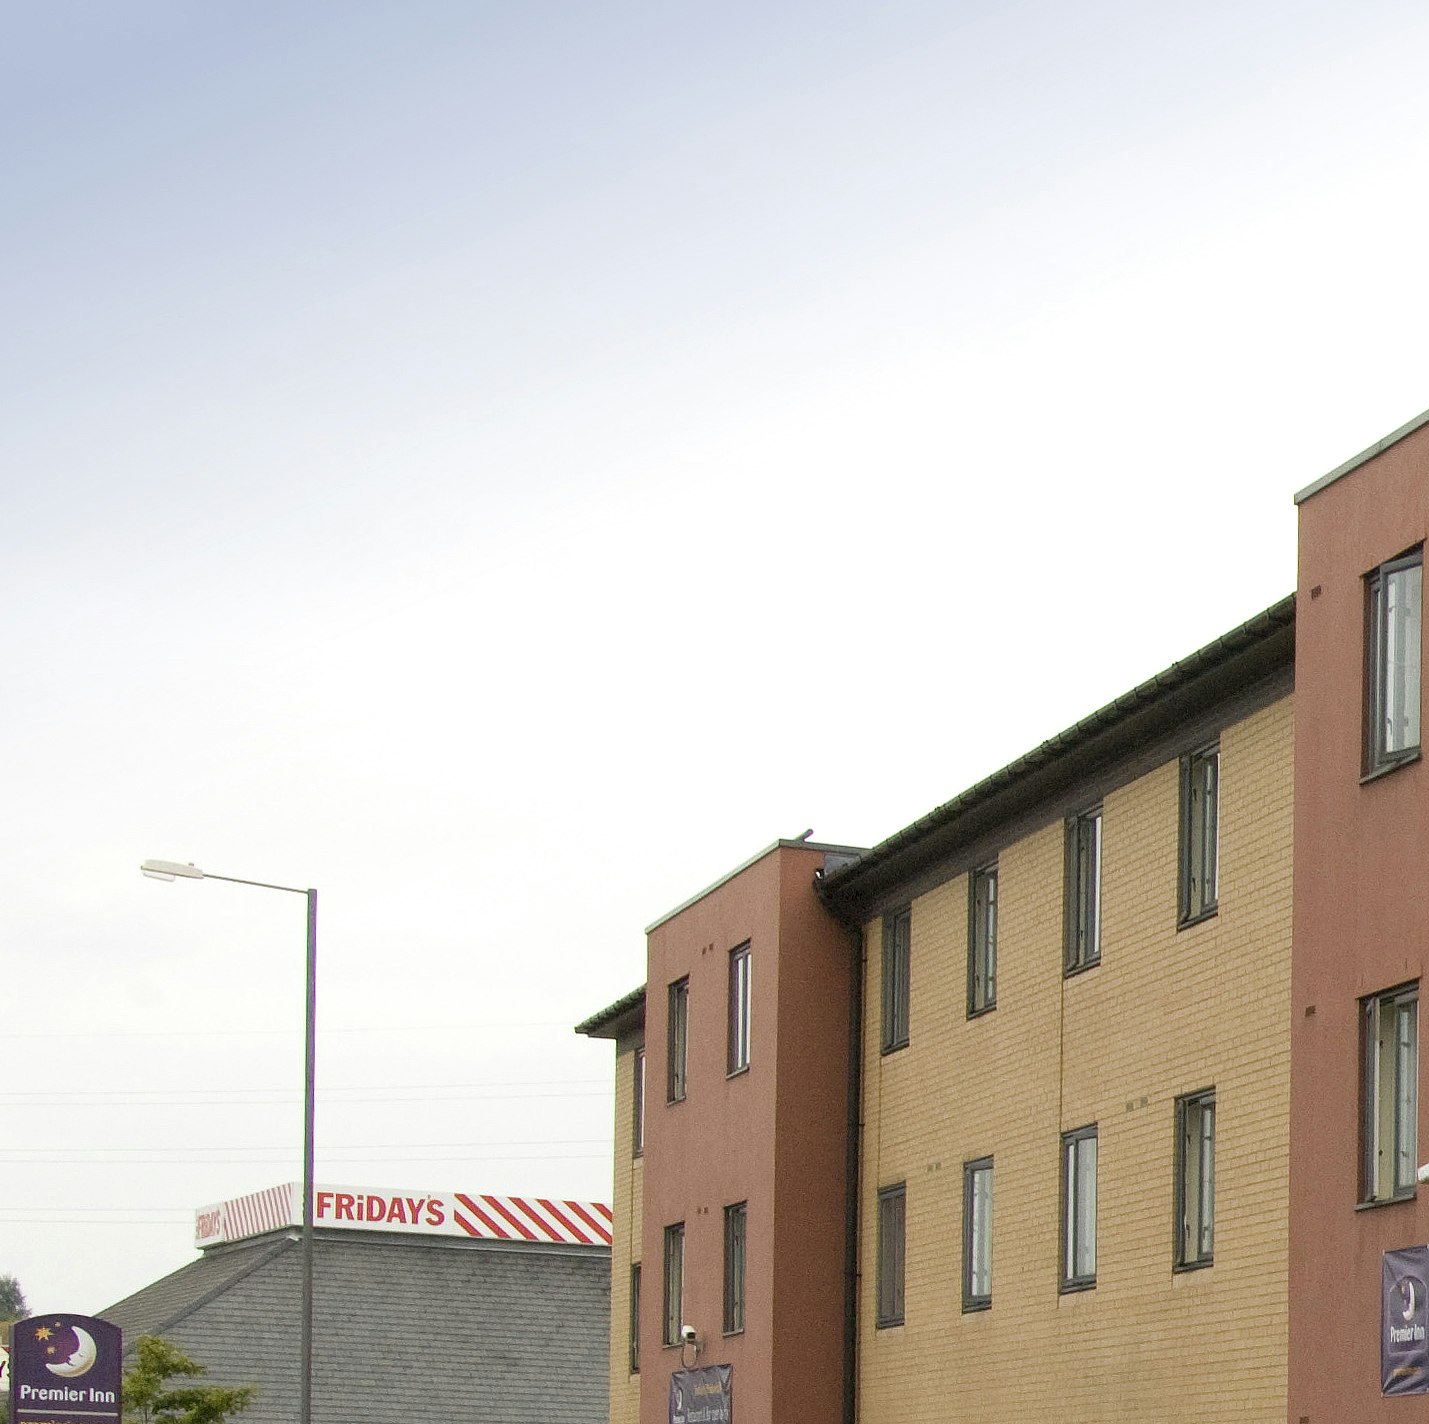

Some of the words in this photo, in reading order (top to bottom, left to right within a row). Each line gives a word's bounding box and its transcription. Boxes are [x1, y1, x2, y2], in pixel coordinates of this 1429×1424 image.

[1390, 1324, 1414, 1343] Premier
[1414, 1323, 1425, 1341] Inn
[20, 1384, 87, 1402] Premier
[89, 1387, 115, 1403] Inn
